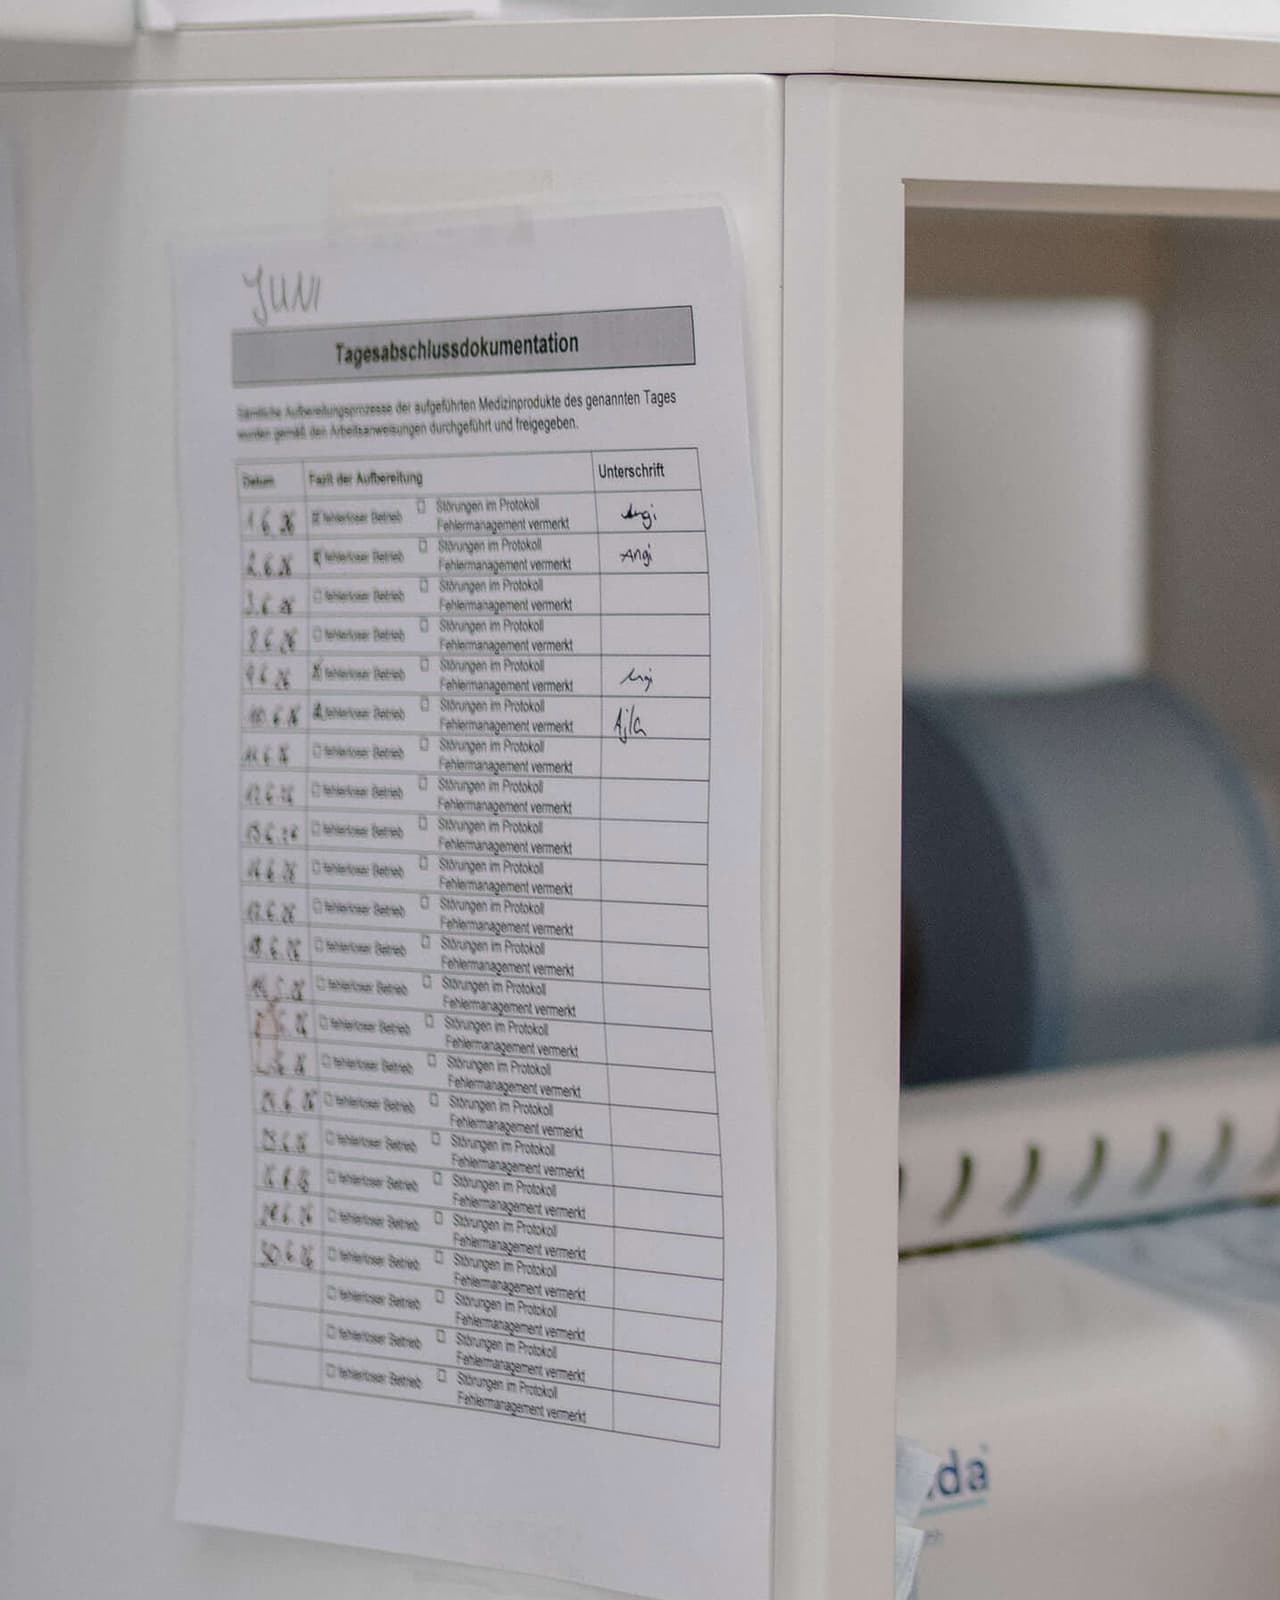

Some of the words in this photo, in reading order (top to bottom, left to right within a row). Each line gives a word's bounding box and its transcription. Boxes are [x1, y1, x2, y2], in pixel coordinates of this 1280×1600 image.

[335, 332, 579, 368] Tagesabschlussdokumentation
[396, 400, 411, 414] der
[415, 397, 476, 415] aufgeführten
[479, 395, 561, 413] Medizinprodukte
[564, 394, 583, 408] des
[585, 392, 640, 410] genannten
[643, 389, 677, 408] Tages
[430, 419, 492, 437] durchgeführt
[495, 418, 513, 432] und
[516, 415, 579, 435] freigegeben.
[309, 472, 333, 486] Fazit
[336, 472, 352, 485] der
[357, 471, 423, 488] Aufbereitung
[599, 462, 665, 479] Unterschrift
[436, 500, 483, 515] Störungen
[486, 499, 497, 511] im
[500, 497, 541, 511] Protokoll
[437, 518, 526, 535] Fehlermanagement
[528, 516, 569, 530] vermerkt
[438, 540, 484, 555] Störungen
[488, 539, 498, 551] im
[502, 537, 542, 551] Protokoll
[438, 558, 527, 575] Fehlermanagement
[529, 557, 571, 570] vermerkt
[439, 579, 485, 595] Störungen
[489, 579, 499, 591] im
[503, 577, 543, 591] Protokoll
[440, 598, 528, 615] Fehlermanagement
[530, 597, 572, 610] vermerkt
[440, 619, 486, 634] Störungen
[490, 619, 500, 631] im
[503, 618, 544, 631] Protokoll
[440, 638, 529, 655] Fehlermanagement
[531, 638, 572, 651] vermerkt
[440, 658, 487, 674] Störungen
[490, 659, 500, 671] im
[504, 658, 544, 671] Protokoll
[441, 677, 529, 694] Fehlermanagement
[531, 678, 573, 691] vermerkt
[440, 698, 486, 714] Störungen
[490, 699, 500, 711] im
[504, 698, 544, 711] Protokoll
[441, 717, 529, 734] Fehlermanagement
[531, 719, 573, 732] vermerkt
[440, 737, 486, 754] Störungen
[489, 739, 500, 751] im
[503, 738, 544, 752] Protokoll
[440, 756, 528, 774] Fehlermanagement
[530, 759, 572, 772] vermerkt
[438, 777, 485, 793] Störungen
[488, 779, 499, 791] im
[502, 778, 543, 792] Protokoll
[439, 796, 528, 814] Fehlermanagement
[530, 800, 572, 813] vermerkt
[438, 816, 485, 833] Störungen
[488, 818, 499, 831] im
[502, 818, 543, 832] Protokoll
[439, 835, 528, 854] Fehlermanagement
[530, 840, 572, 853] vermerkt
[439, 856, 486, 873] Störungen
[489, 858, 500, 871] im
[503, 858, 544, 872] Protokoll
[440, 875, 528, 894] Fehlermanagement
[530, 881, 572, 894] vermerkt
[440, 895, 487, 913] Störungen
[490, 898, 501, 911] im
[504, 898, 544, 913] Protokoll
[441, 914, 529, 934] Fehlermanagement
[531, 921, 573, 934] vermerkt
[441, 935, 488, 952] Störungen
[491, 938, 502, 951] im
[505, 938, 545, 953] Protokoll
[442, 954, 530, 974] Fehlermanagement
[532, 962, 574, 975] vermerkt
[506, 978, 547, 994] Protokoll
[508, 1018, 549, 1034] Protokoll
[511, 1059, 552, 1075] Protokoll
[513, 1099, 554, 1115] Protokoll
[515, 1139, 555, 1156] Protokoll
[516, 1179, 556, 1196] Protokoll
[517, 1219, 557, 1237] Protokoll
[517, 1259, 557, 1277] Protokoll
[517, 1300, 557, 1317] Protokoll
[518, 1340, 557, 1358] Protokoll
[519, 1380, 558, 1398] Protokoll
